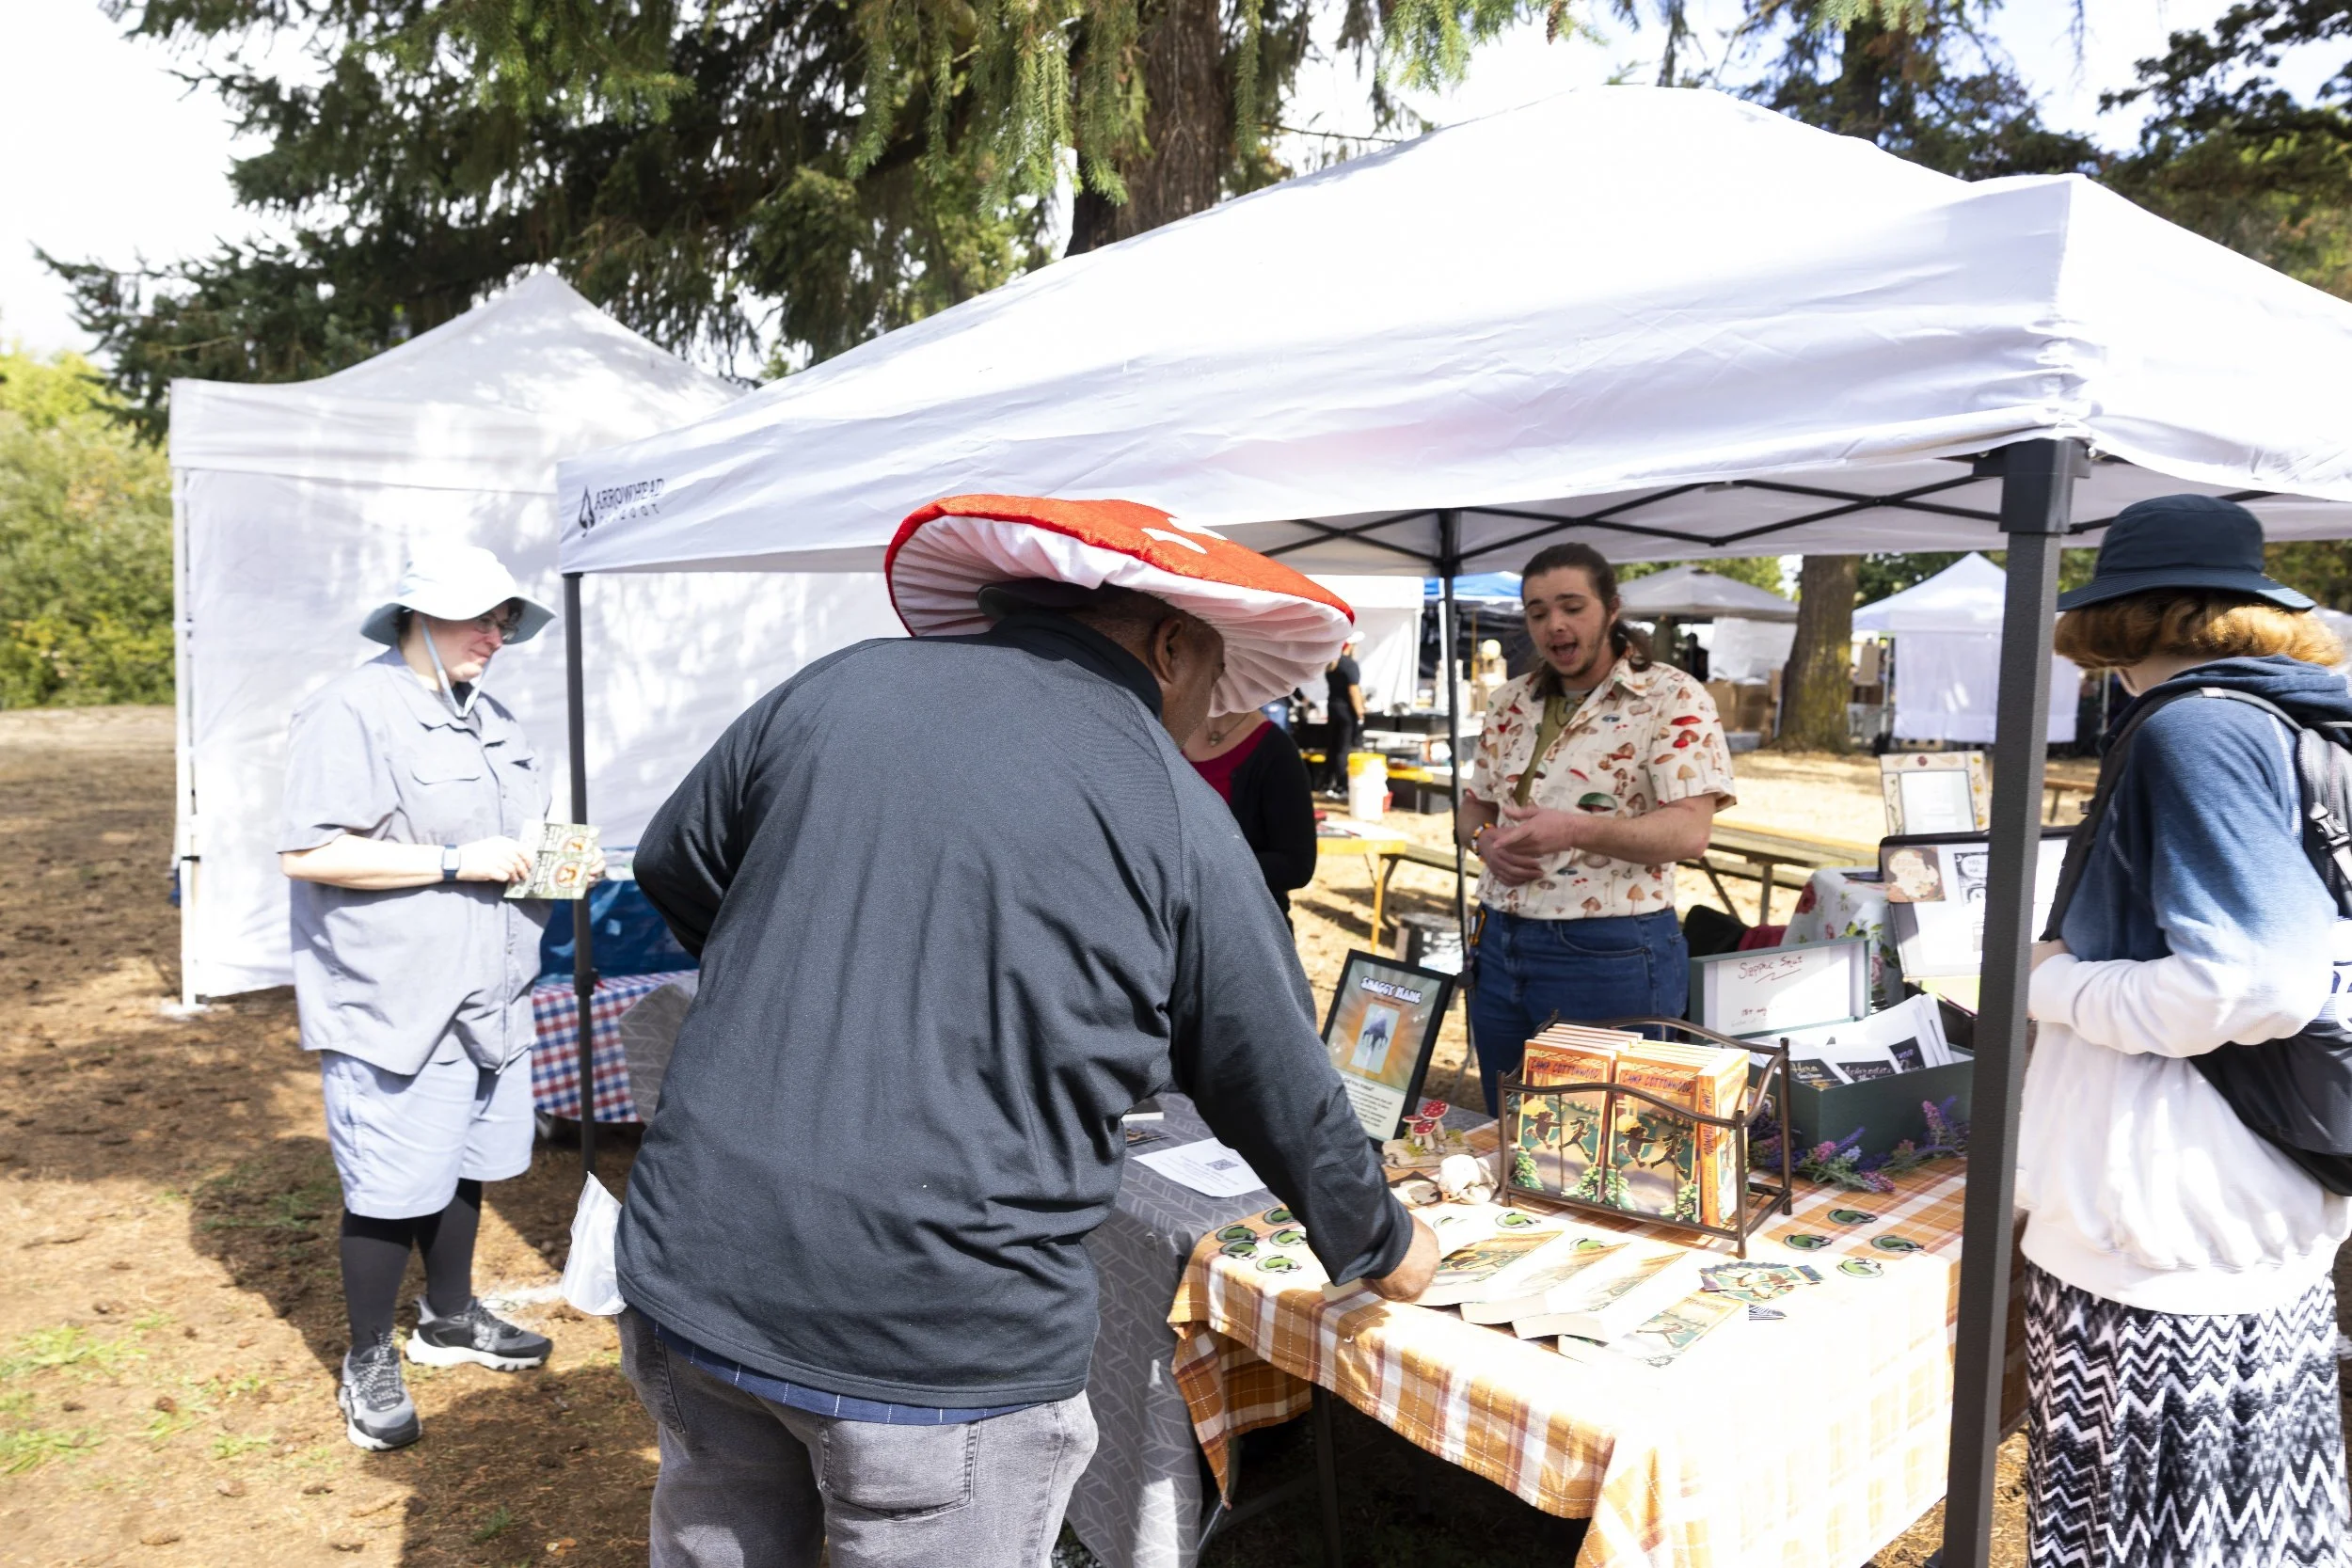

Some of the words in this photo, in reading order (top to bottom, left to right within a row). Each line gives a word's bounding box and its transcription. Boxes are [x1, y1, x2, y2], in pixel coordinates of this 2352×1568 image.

[595, 478, 664, 510] ARROWHEAD
[1779, 955, 1804, 968] Smut
[1531, 1059, 1551, 1070] CAMP
[1552, 1062, 1600, 1080] COTTONWOOD
[1622, 1071, 1642, 1084] CAMP
[1644, 1075, 1692, 1093] COTTONWOOD
[1701, 1088, 1712, 1109] CAMP
